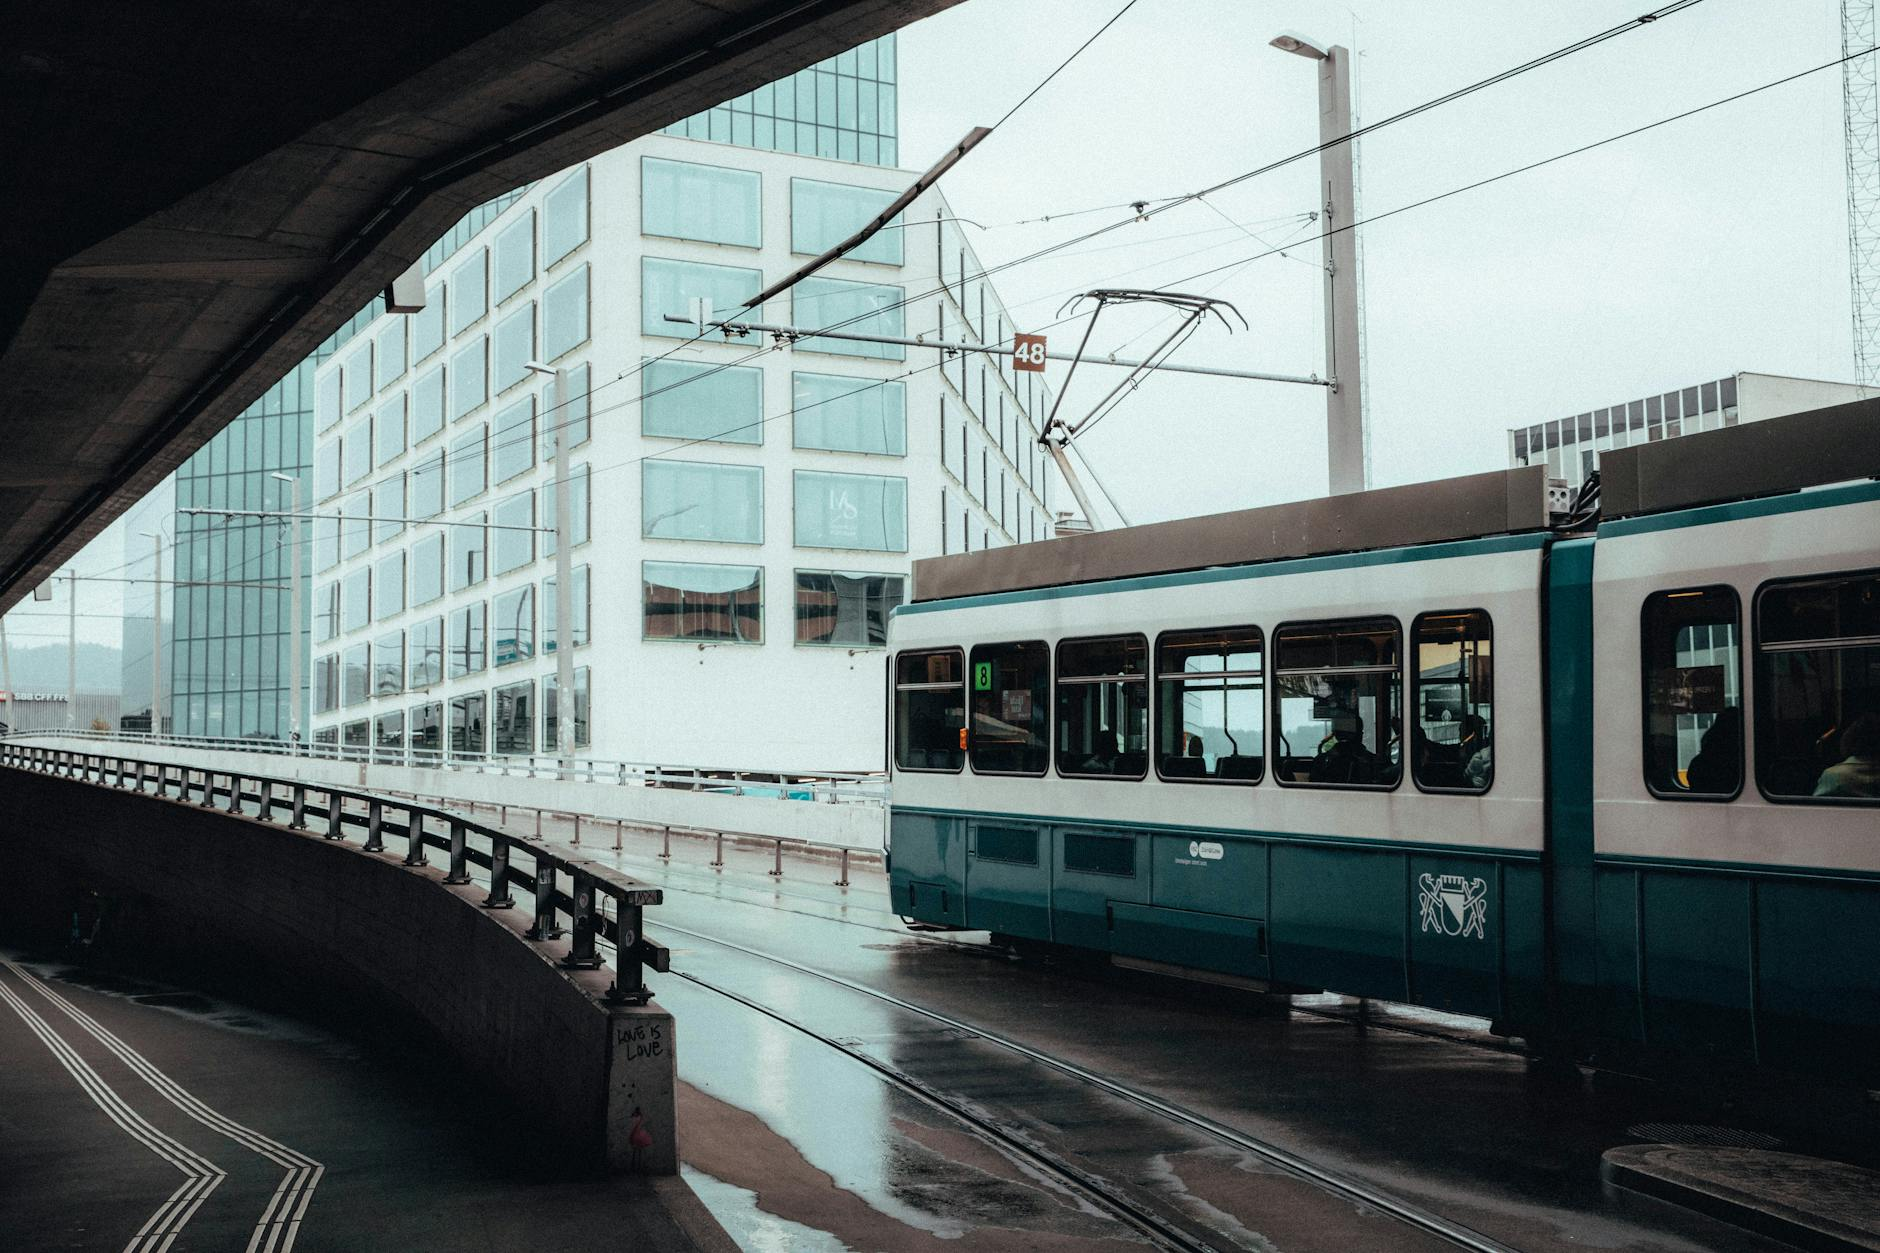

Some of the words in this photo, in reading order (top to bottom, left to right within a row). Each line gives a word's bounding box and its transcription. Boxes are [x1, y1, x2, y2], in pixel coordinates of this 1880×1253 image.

[1015, 342, 1045, 365] 48
[981, 667, 987, 686] 8
[617, 1026, 645, 1045] LOVE
[650, 1025, 661, 1039] IS
